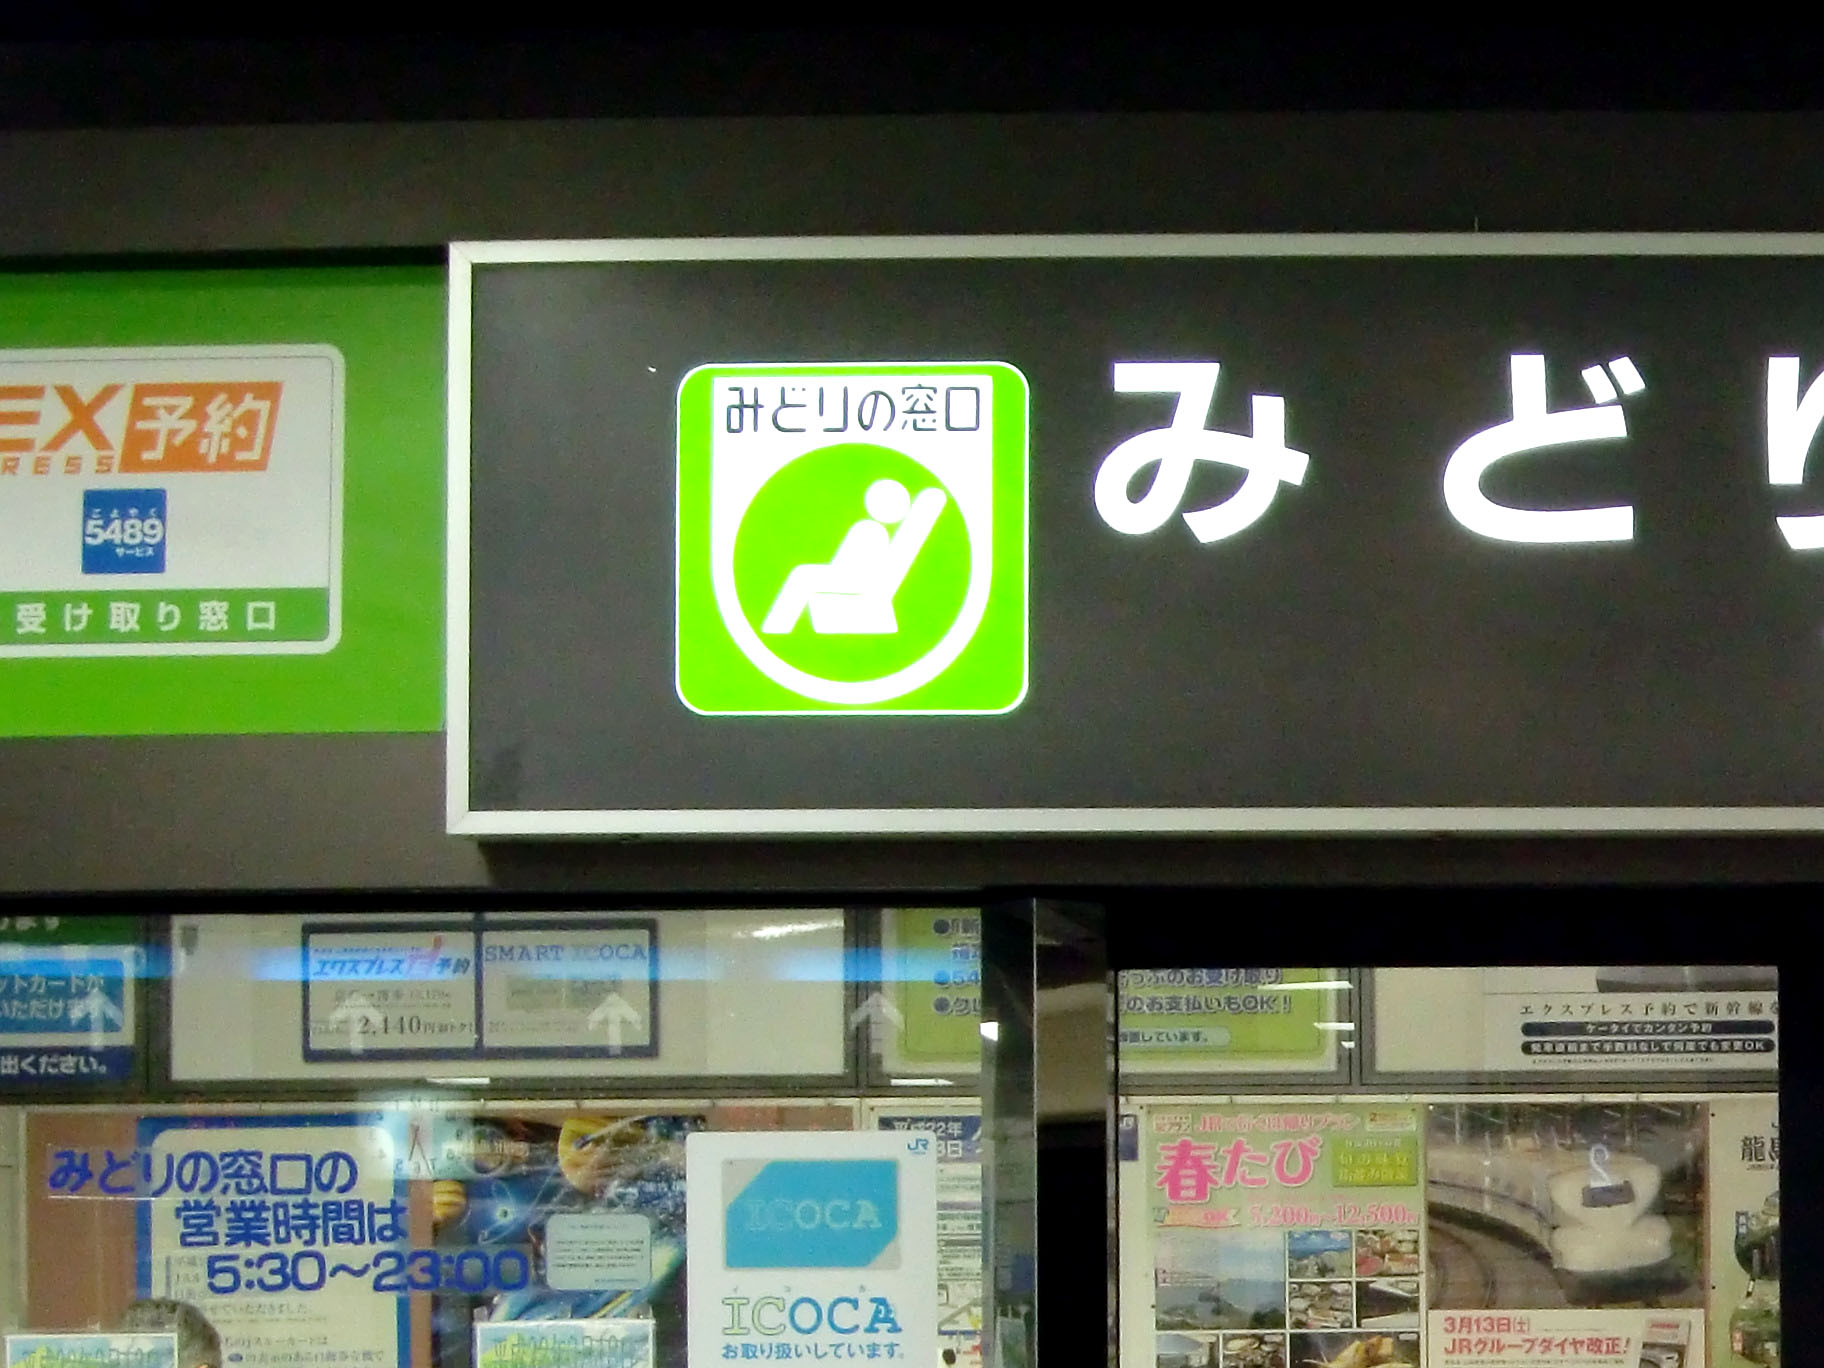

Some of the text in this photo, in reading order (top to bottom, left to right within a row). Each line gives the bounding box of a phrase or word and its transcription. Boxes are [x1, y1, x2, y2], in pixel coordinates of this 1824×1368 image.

[726, 384, 980, 432] みどりの窓口
[84, 521, 164, 546] 5489
[484, 943, 564, 963] SMART
[907, 1138, 928, 1150] JR
[48, 1151, 358, 1197] みどりの窓口の
[1156, 1137, 1322, 1203] 春たび
[175, 1200, 408, 1248] 営業時間は
[750, 1200, 882, 1230] ICOCA
[722, 1296, 903, 1335] ICOCA
[721, 1340, 904, 1360] お取り扱いしています。
